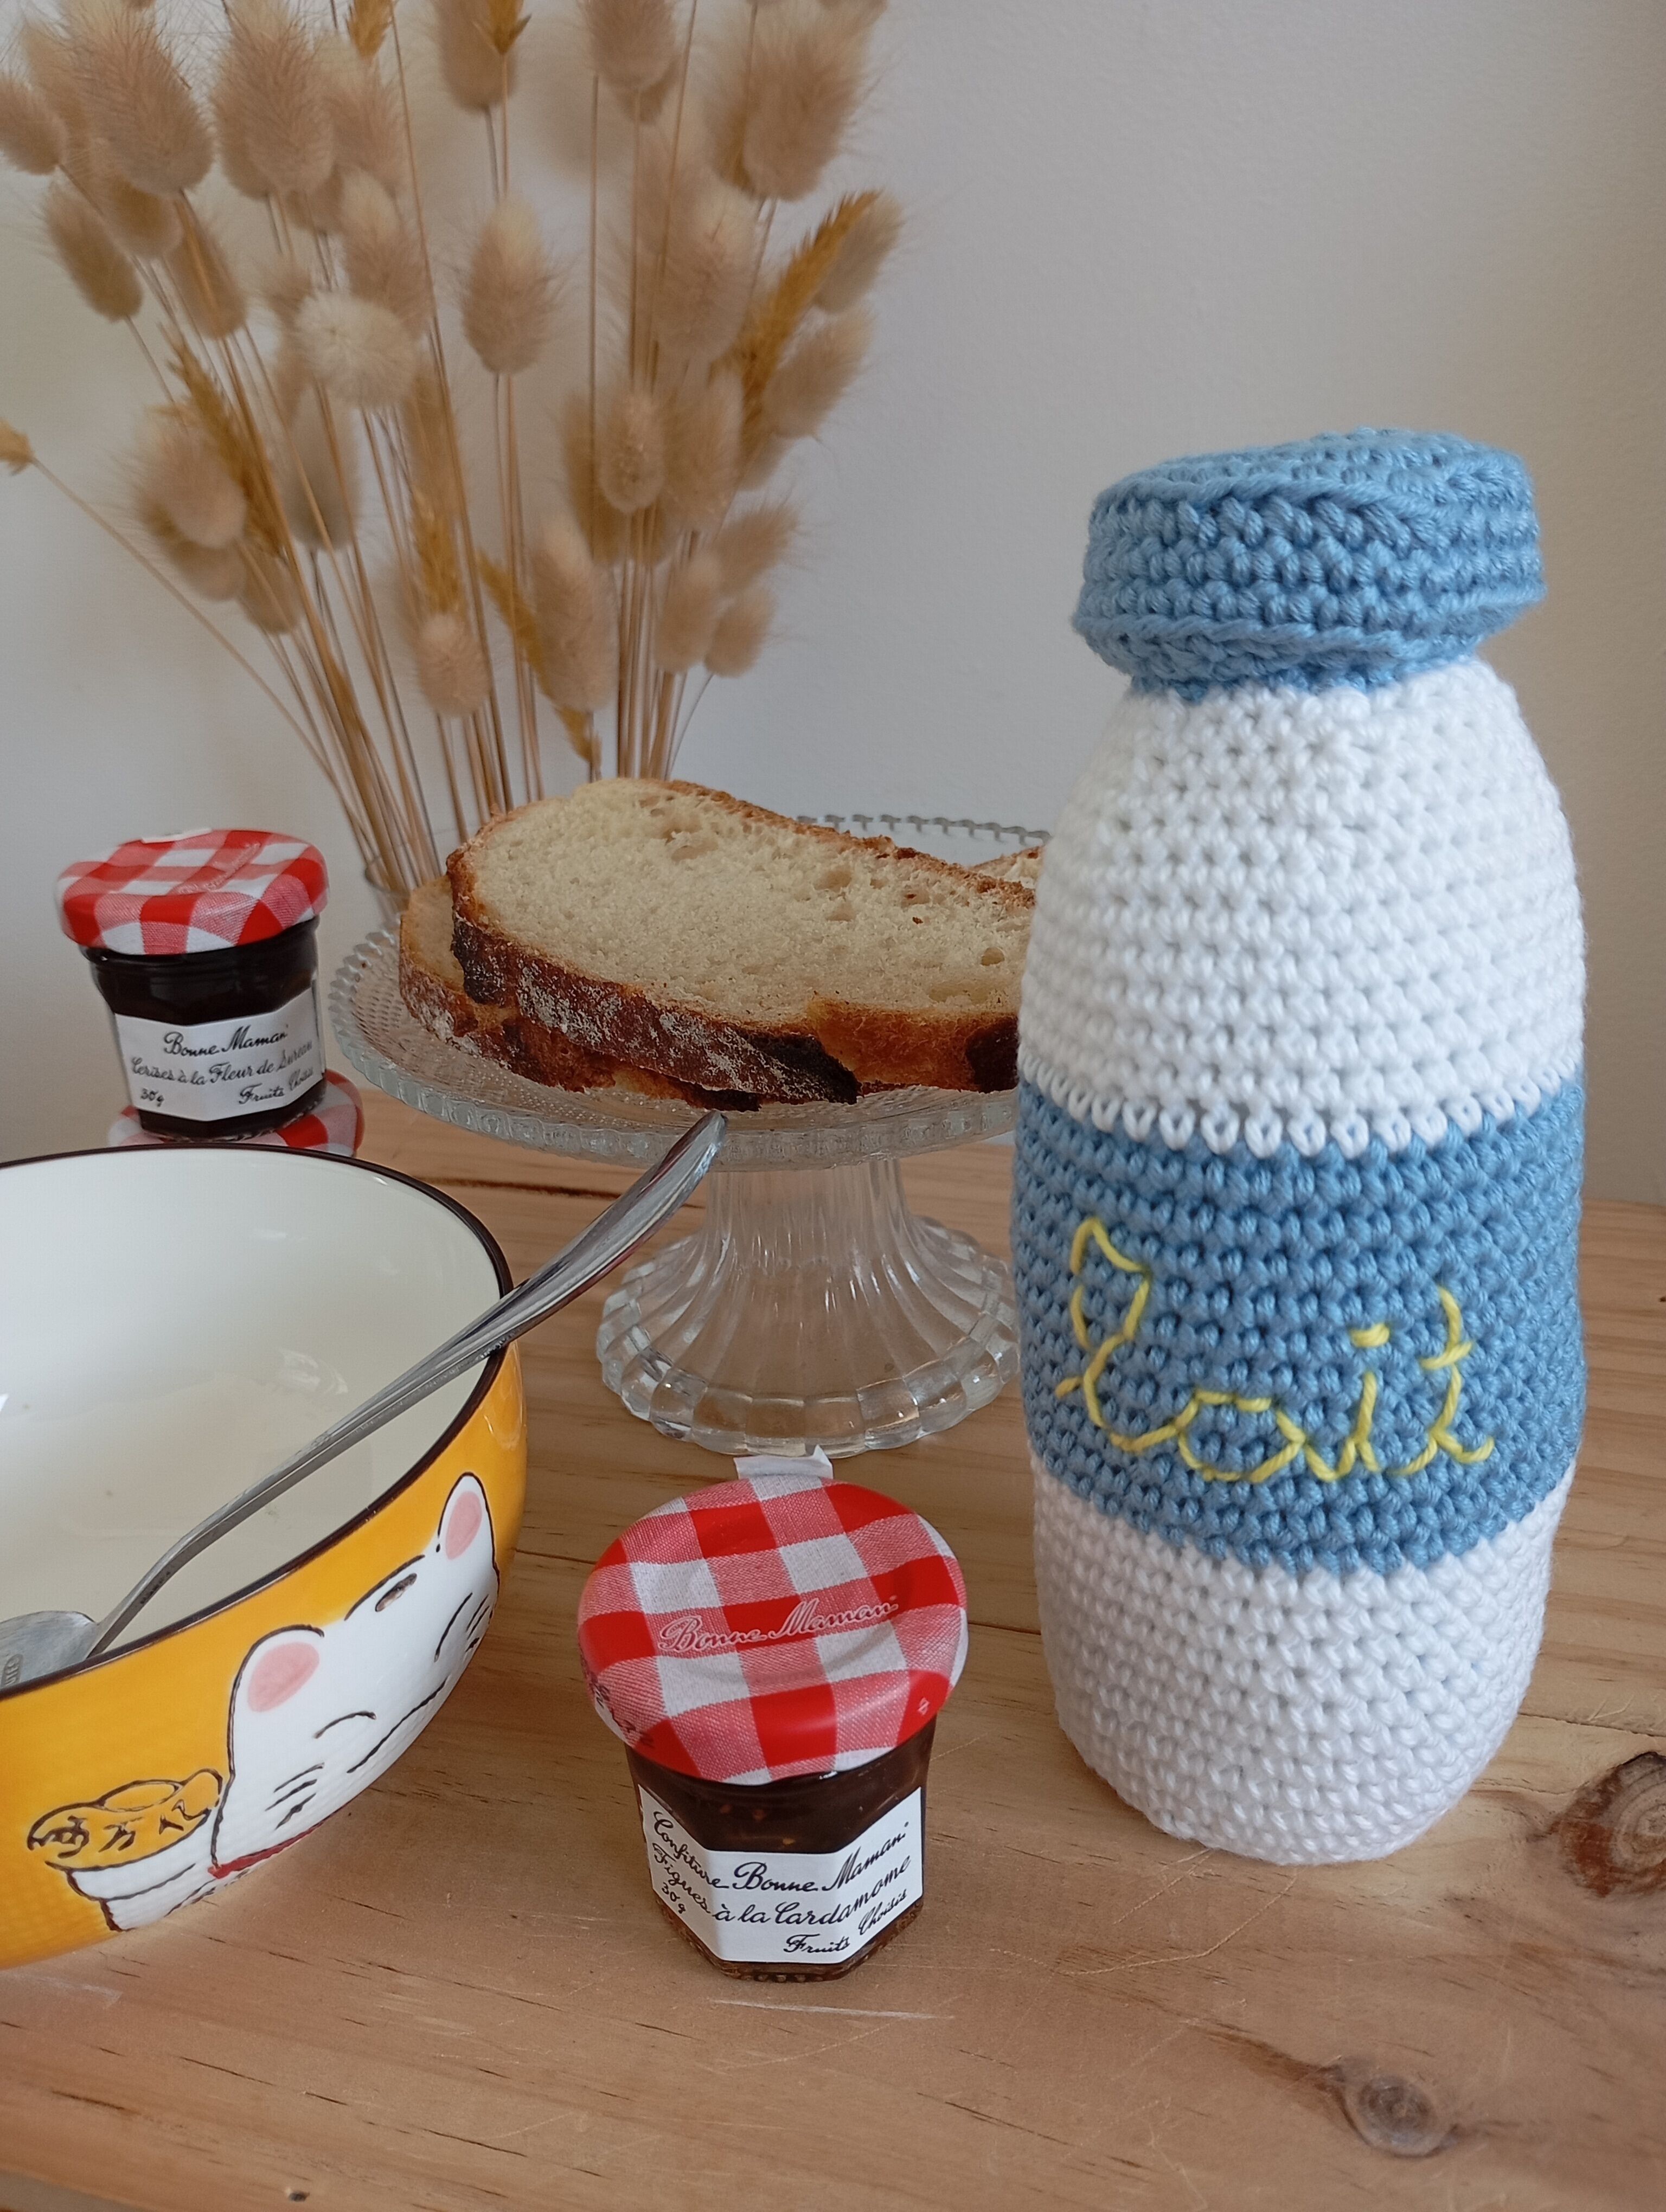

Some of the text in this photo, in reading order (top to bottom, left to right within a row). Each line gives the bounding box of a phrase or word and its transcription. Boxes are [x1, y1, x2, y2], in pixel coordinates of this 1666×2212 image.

[164, 1025, 287, 1057] Bonne Maman
[131, 1056, 175, 1082] Cerises
[177, 1069, 188, 1083] à
[189, 1071, 207, 1085] la
[209, 1062, 253, 1083] Fleur
[257, 1059, 274, 1074] de
[239, 1083, 285, 1105] Fruits
[658, 1598, 899, 1652] Bonne Maman
[653, 1811, 906, 1892] Confiture Bonne Maman
[652, 1842, 911, 1925] Figues à la Cardamome
[784, 1889, 907, 1953] Fruits Choisis
